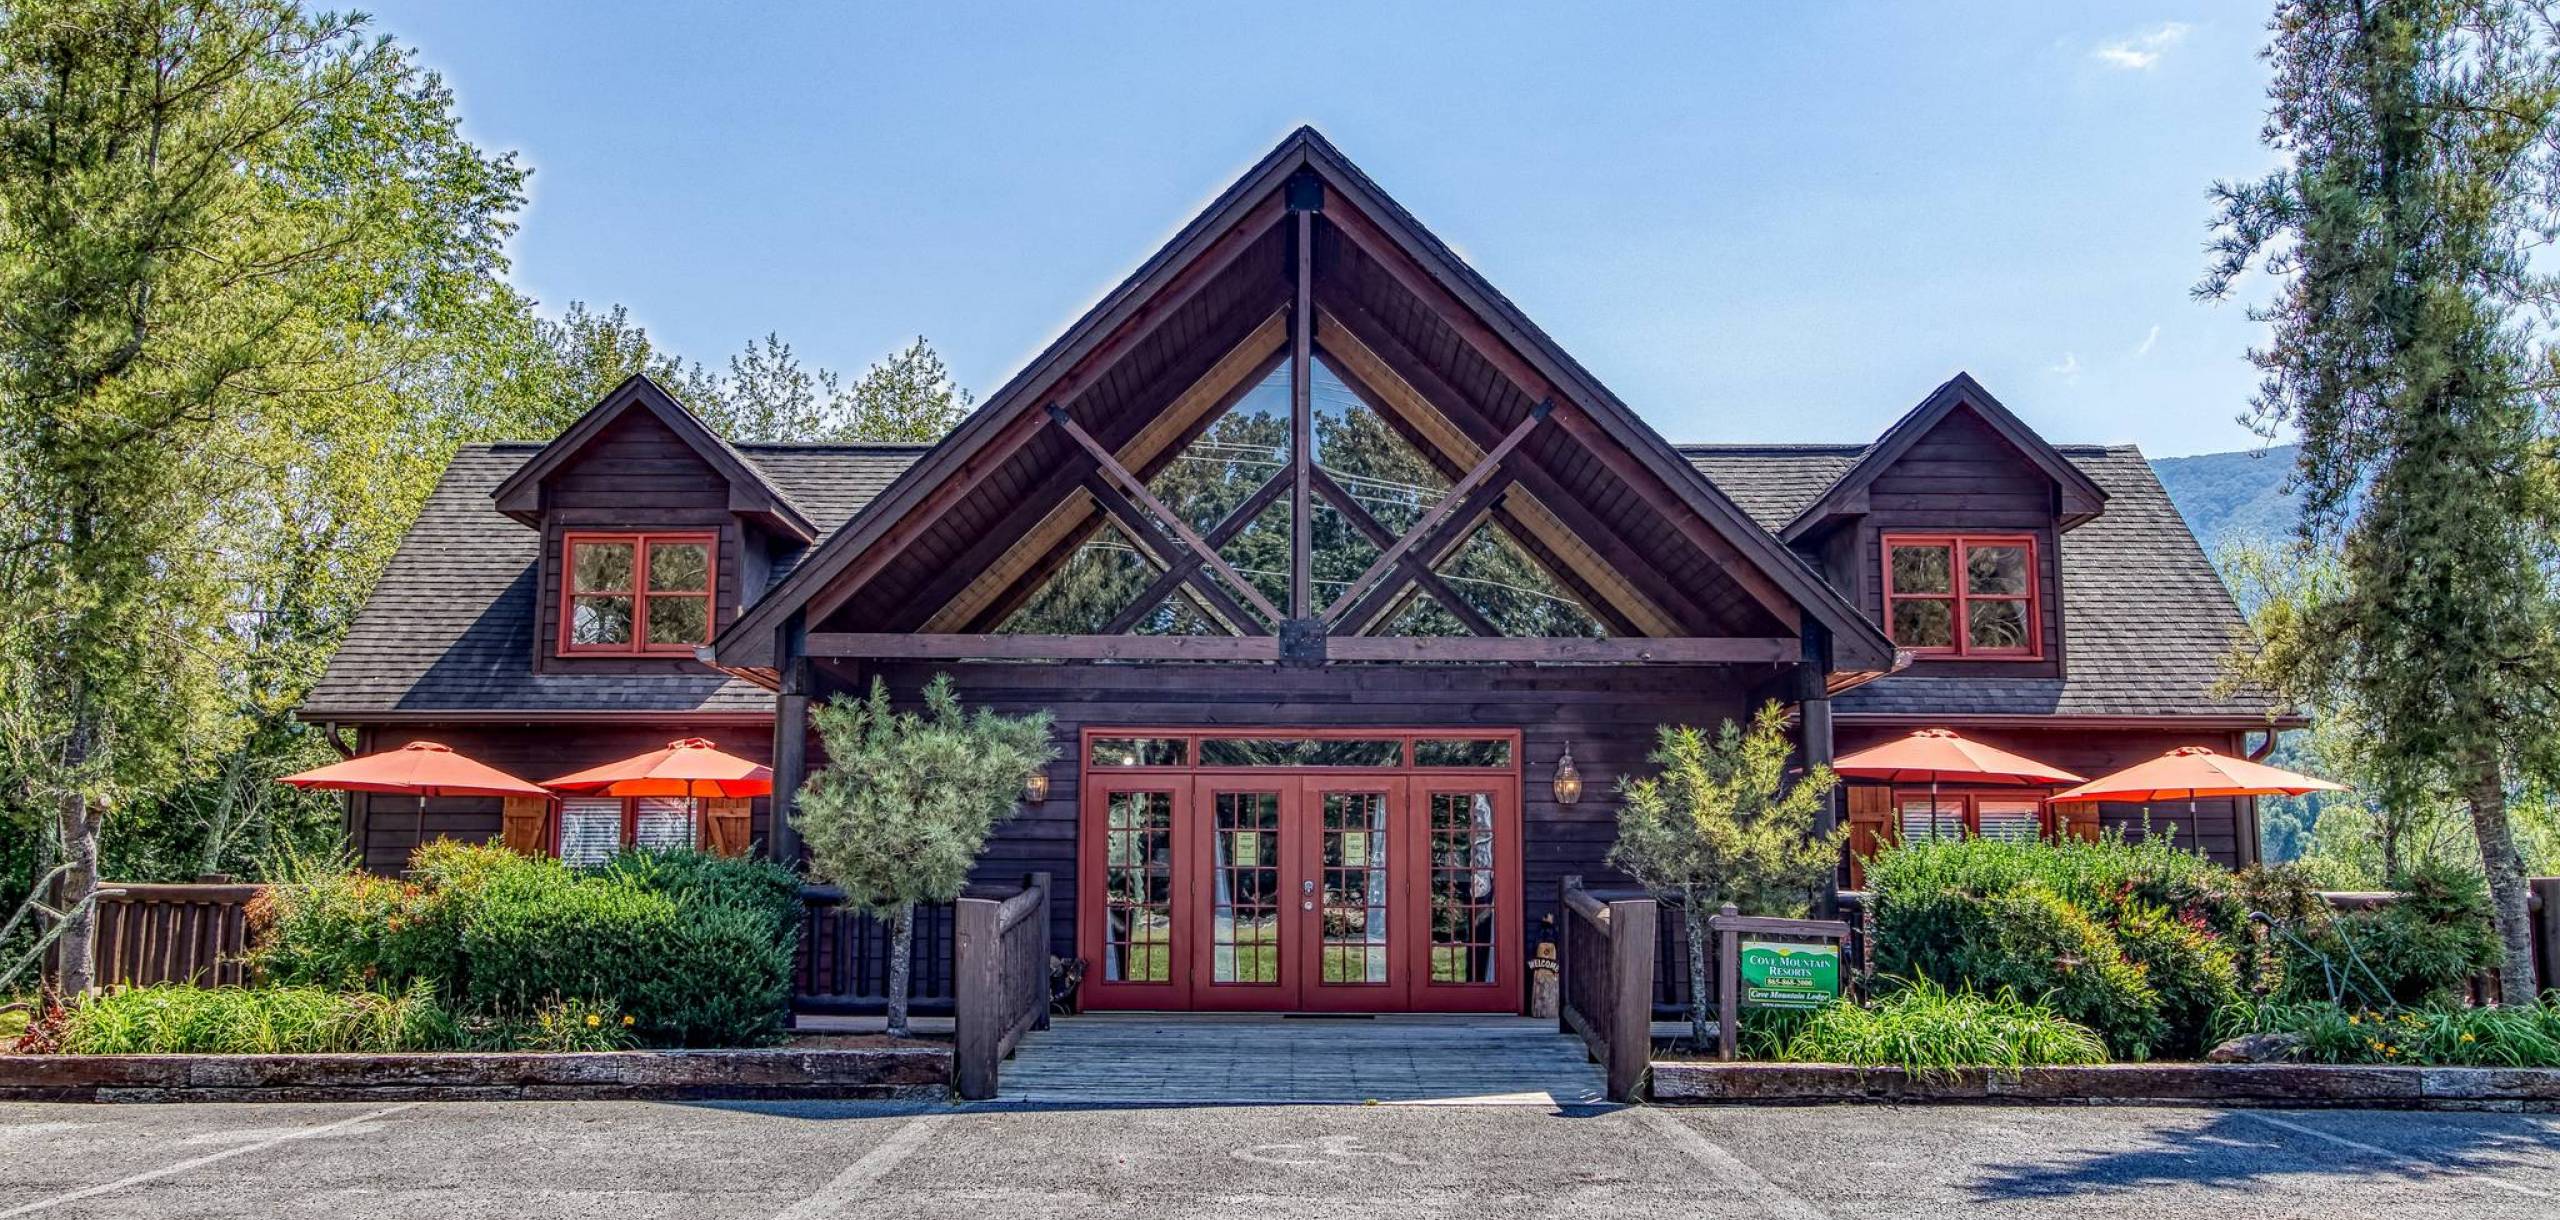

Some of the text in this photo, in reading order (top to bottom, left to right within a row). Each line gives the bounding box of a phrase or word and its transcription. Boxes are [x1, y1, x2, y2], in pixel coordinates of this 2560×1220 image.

[1528, 959, 1559, 972] WELCOME
[1750, 955, 1831, 968] COVE MOUNTAIN
[1769, 966, 1812, 977] RESORTS
[1770, 991, 1805, 999] Mountain
[1807, 993, 1828, 1001] Lodge
